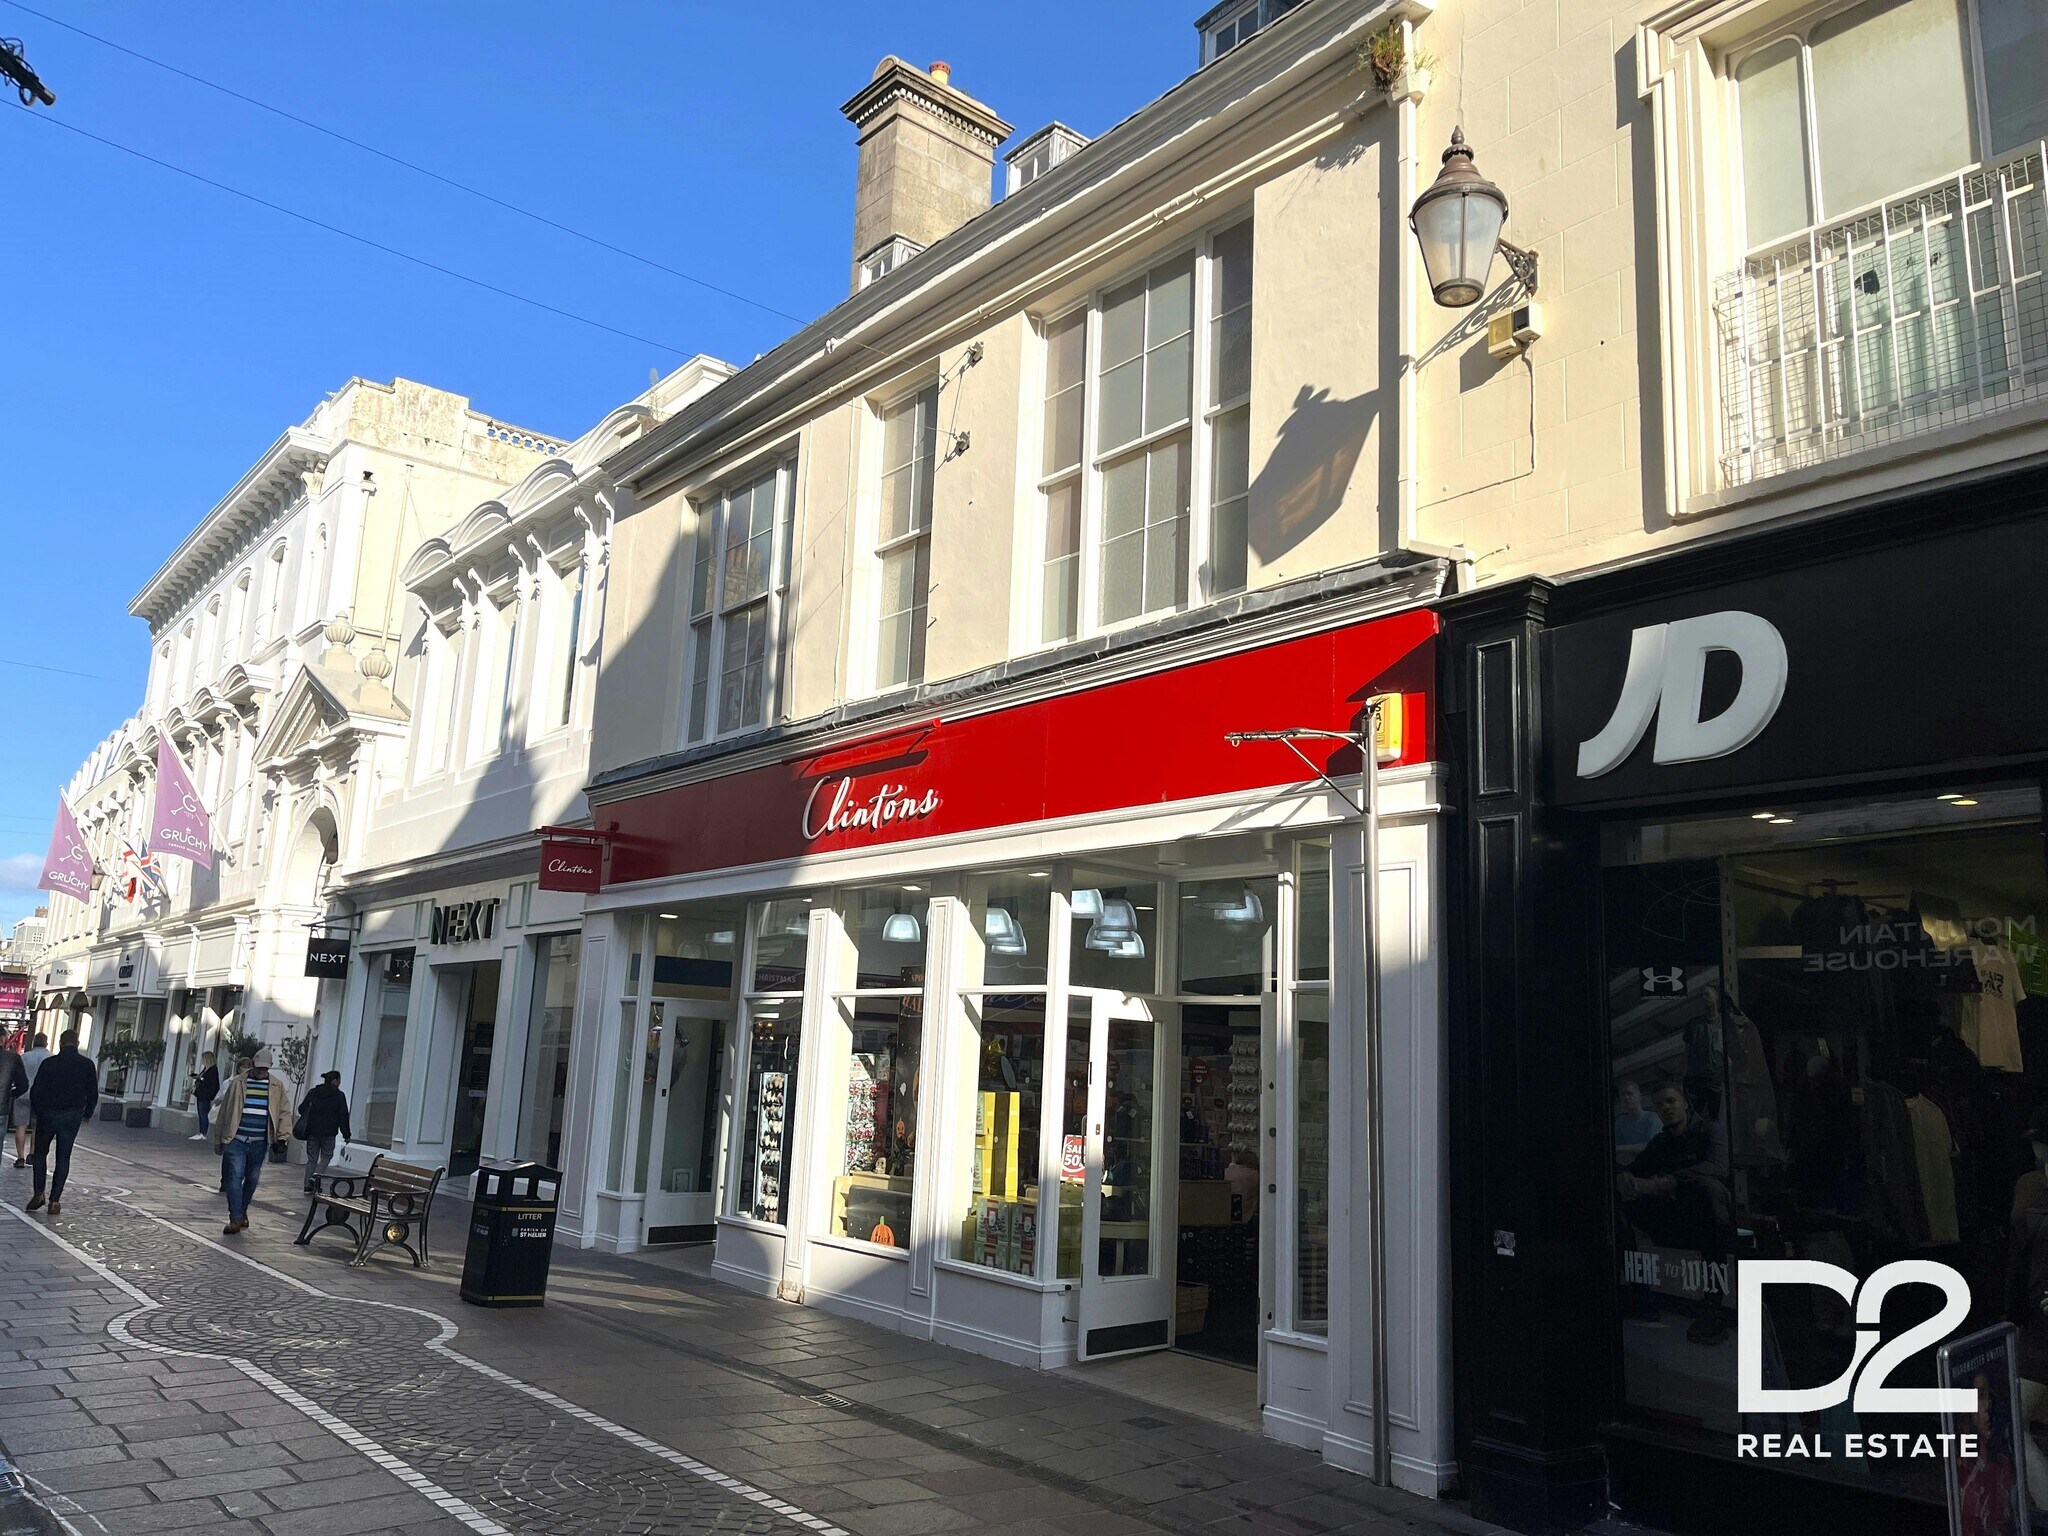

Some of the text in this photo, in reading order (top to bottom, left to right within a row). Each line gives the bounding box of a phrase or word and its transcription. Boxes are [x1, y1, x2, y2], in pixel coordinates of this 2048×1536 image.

[1577, 610, 1788, 779] JD
[802, 775, 938, 840] Clintons
[160, 828, 208, 852] GRUCHY
[548, 858, 594, 874] Clintons
[48, 871, 89, 891] GRUCHY
[430, 898, 501, 945] NEXT
[309, 952, 347, 965] NEXT
[517, 1212, 543, 1220] LITTER
[1624, 1250, 1731, 1296] HERE TO WIN
